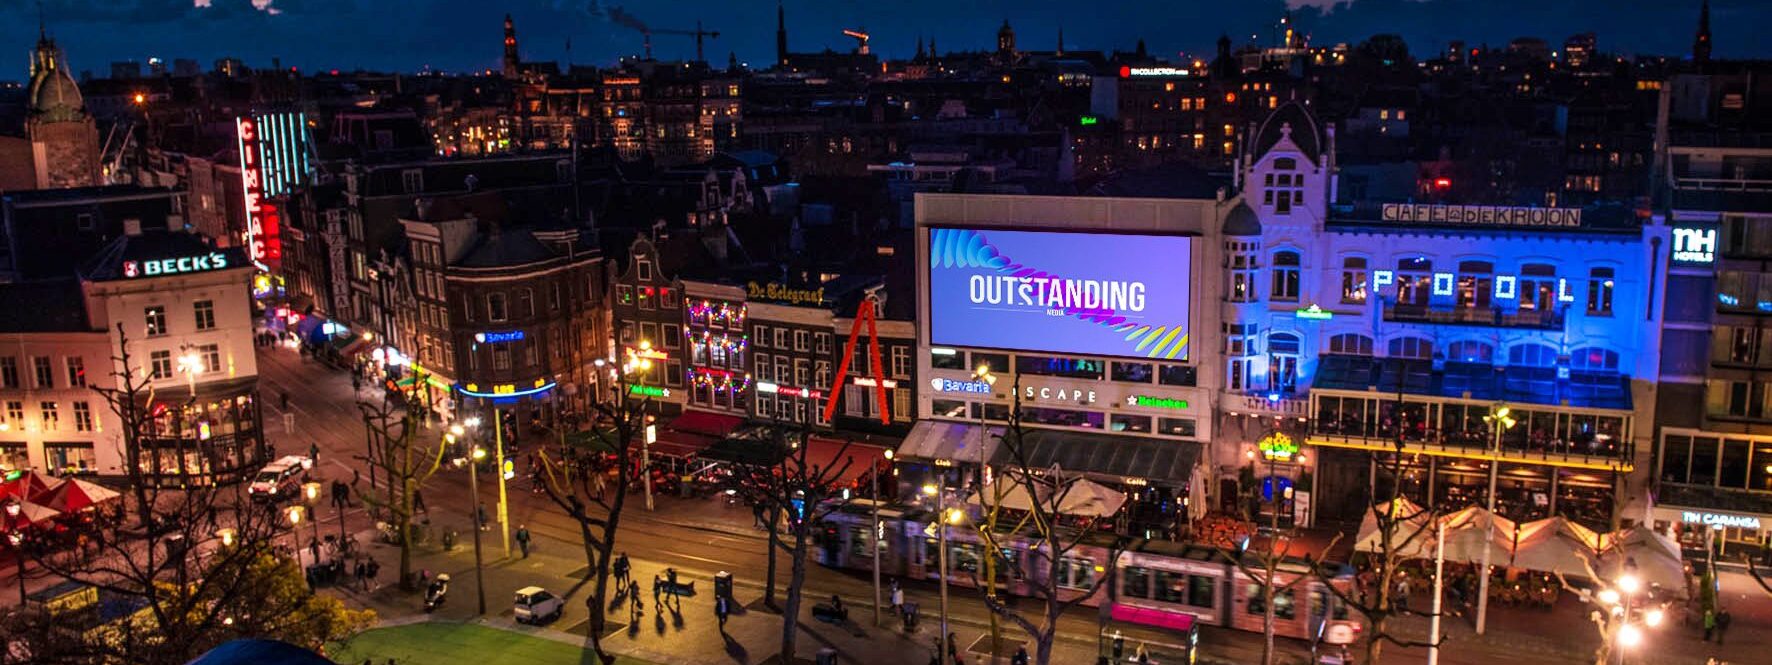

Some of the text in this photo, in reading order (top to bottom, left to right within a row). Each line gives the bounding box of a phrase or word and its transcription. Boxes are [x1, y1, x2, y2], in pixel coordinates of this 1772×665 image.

[240, 121, 266, 259] CINEAC
[144, 252, 227, 275] BECK'S
[1673, 251, 1714, 262] HOTELS
[748, 281, 765, 298] De
[969, 275, 1146, 312] OUTSTANDING
[1373, 270, 1574, 302] POOL
[943, 379, 991, 394] Bavaria
[1138, 395, 1189, 409] Heineken
[1702, 513, 1761, 529] CARANSA
